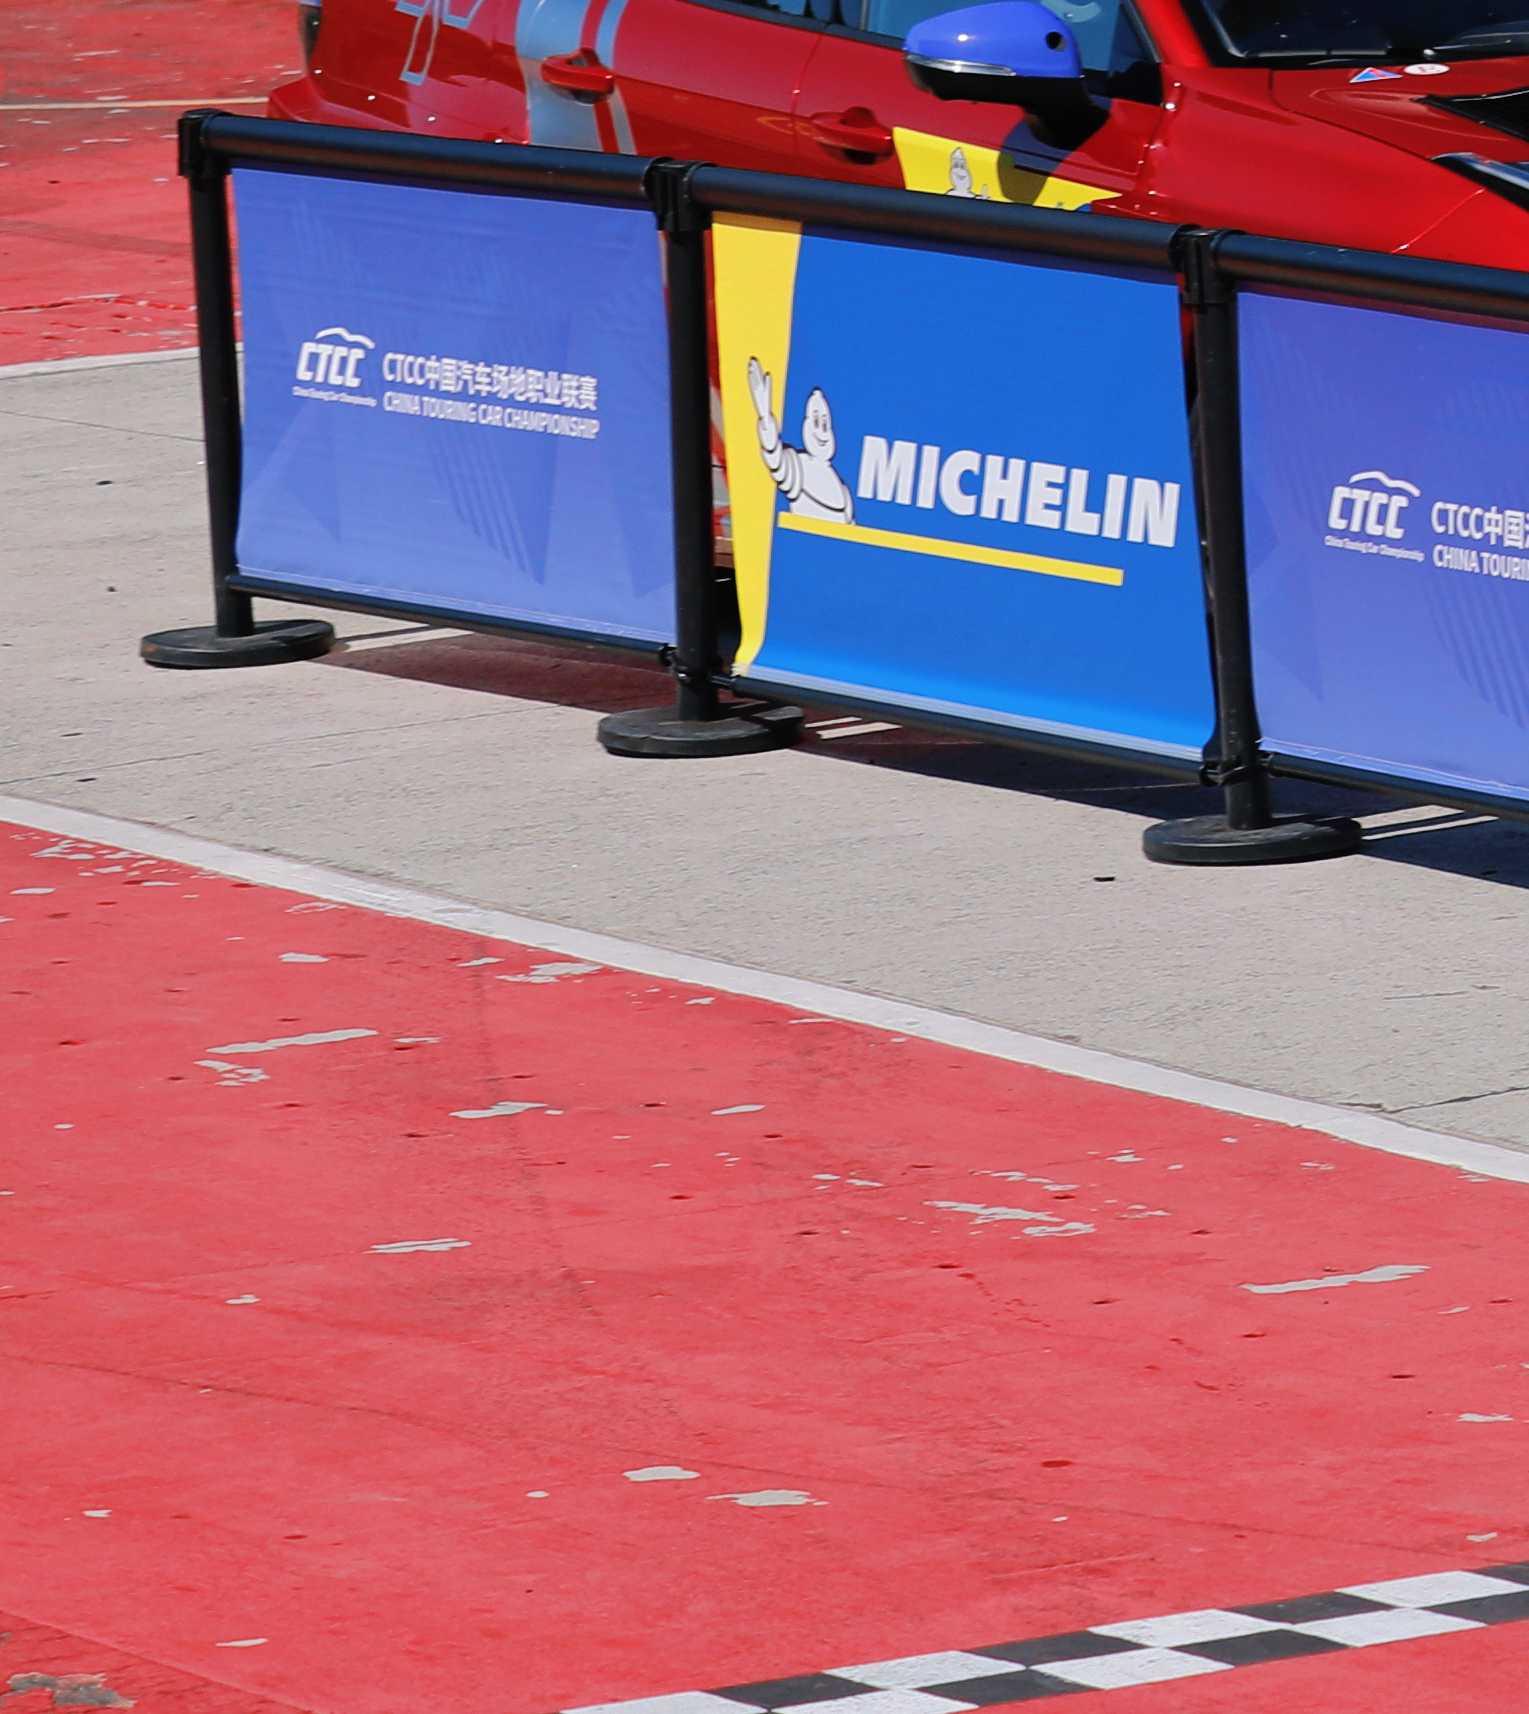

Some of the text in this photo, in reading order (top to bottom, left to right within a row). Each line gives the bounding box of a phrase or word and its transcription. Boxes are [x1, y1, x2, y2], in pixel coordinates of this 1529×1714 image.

[296, 341, 366, 388] CTCC
[382, 352, 598, 412] CTCC中国汽车场地职业联赛
[382, 390, 601, 440] CHINA TOURING CAR CHAMPIONSHIP
[855, 435, 1181, 549] MICHELIN
[1327, 485, 1410, 540] CTCC
[1432, 543, 1480, 574] CHINA
